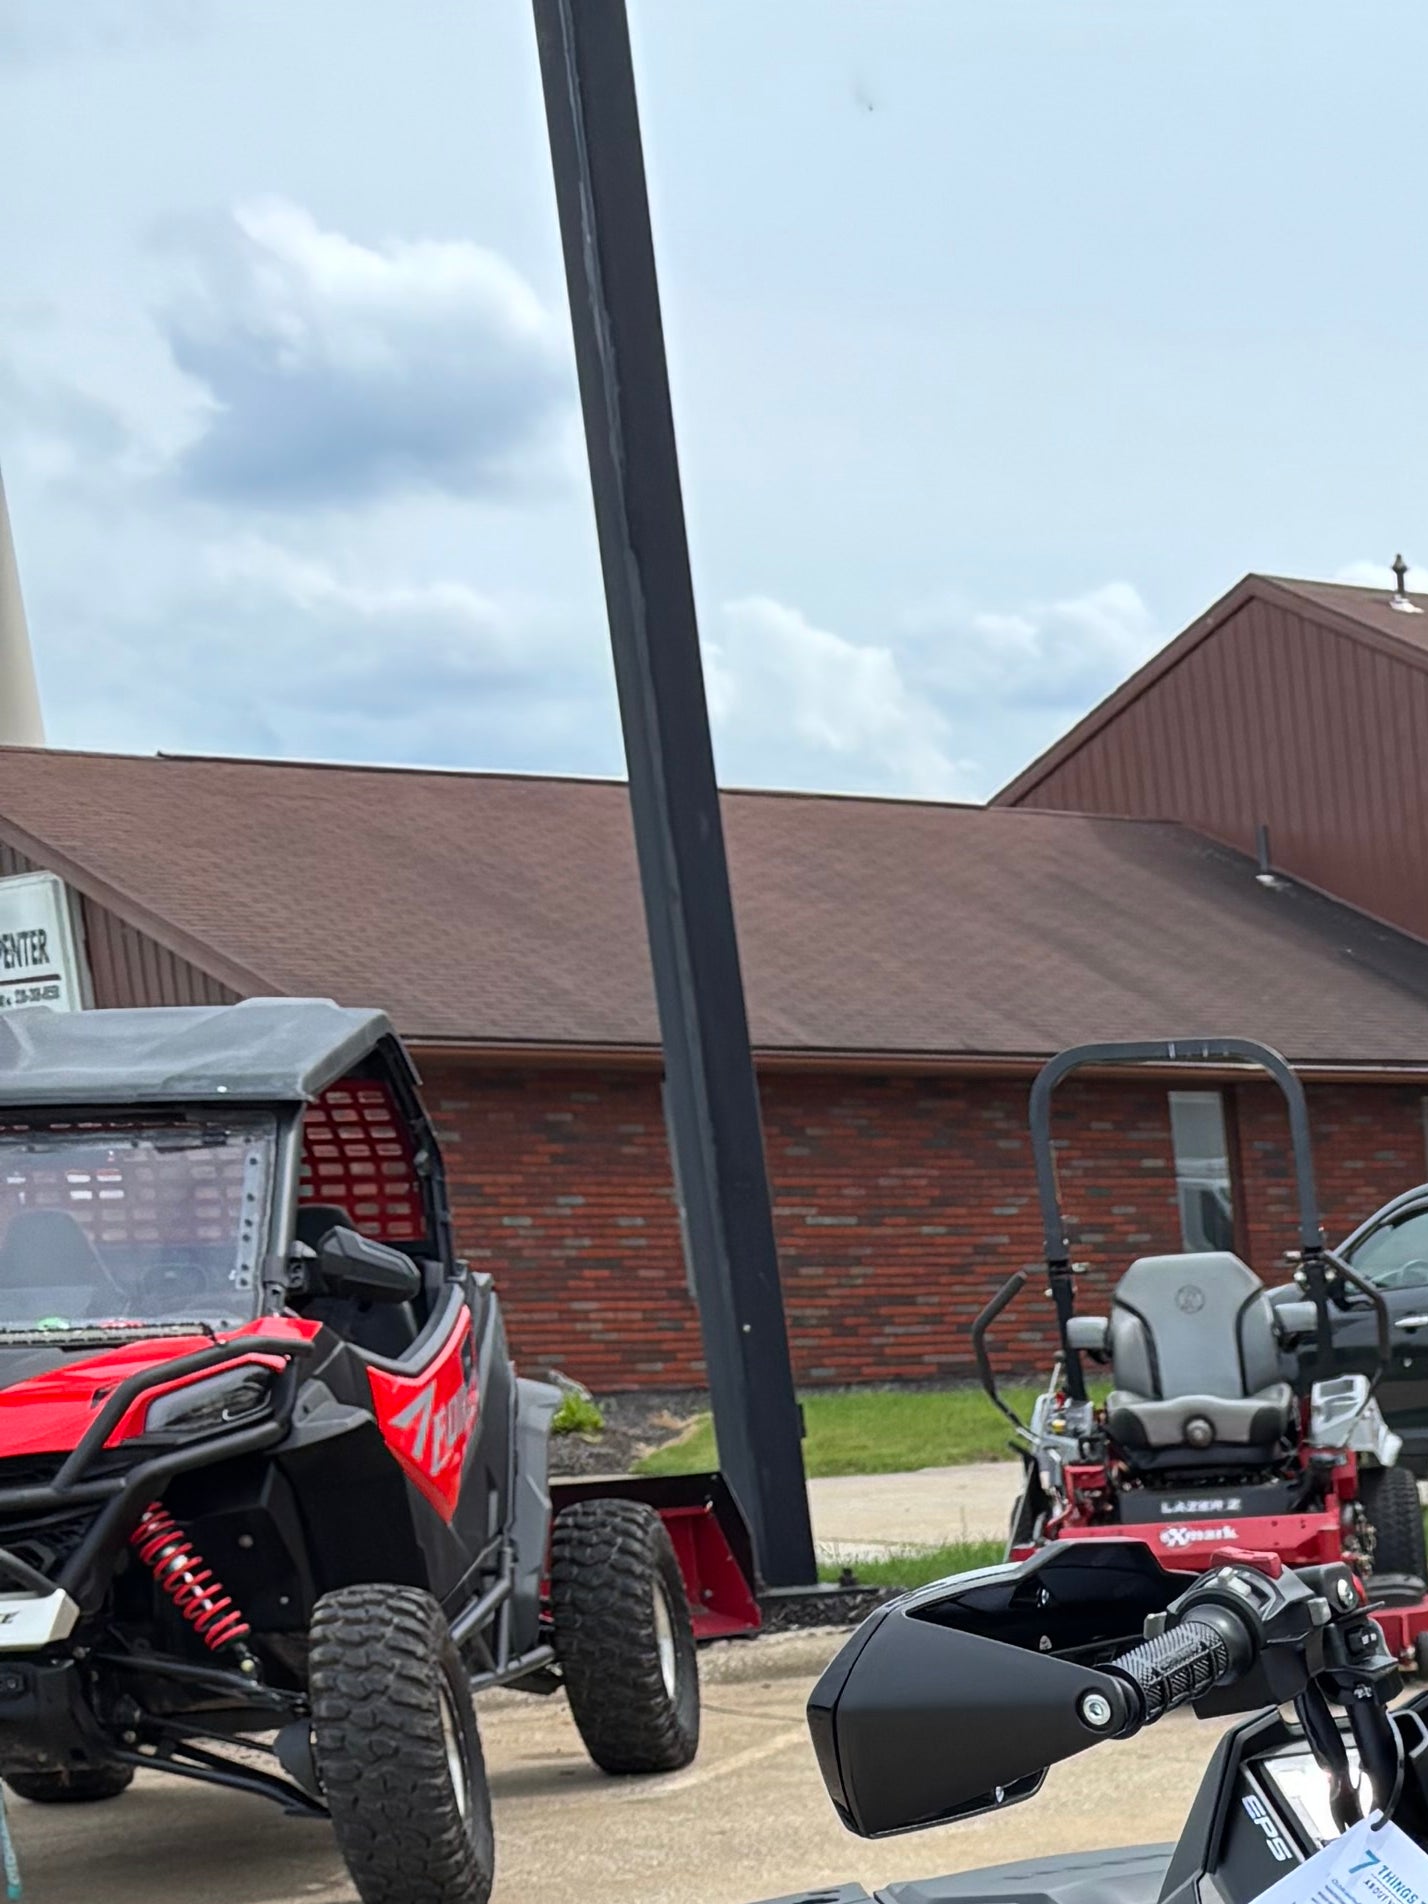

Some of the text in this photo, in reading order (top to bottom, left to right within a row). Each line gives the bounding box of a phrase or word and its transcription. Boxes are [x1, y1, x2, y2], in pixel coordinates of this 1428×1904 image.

[1241, 1794, 1293, 1862] EPS
[1348, 1849, 1381, 1874] 7
[1378, 1864, 1419, 1904] THINGS
